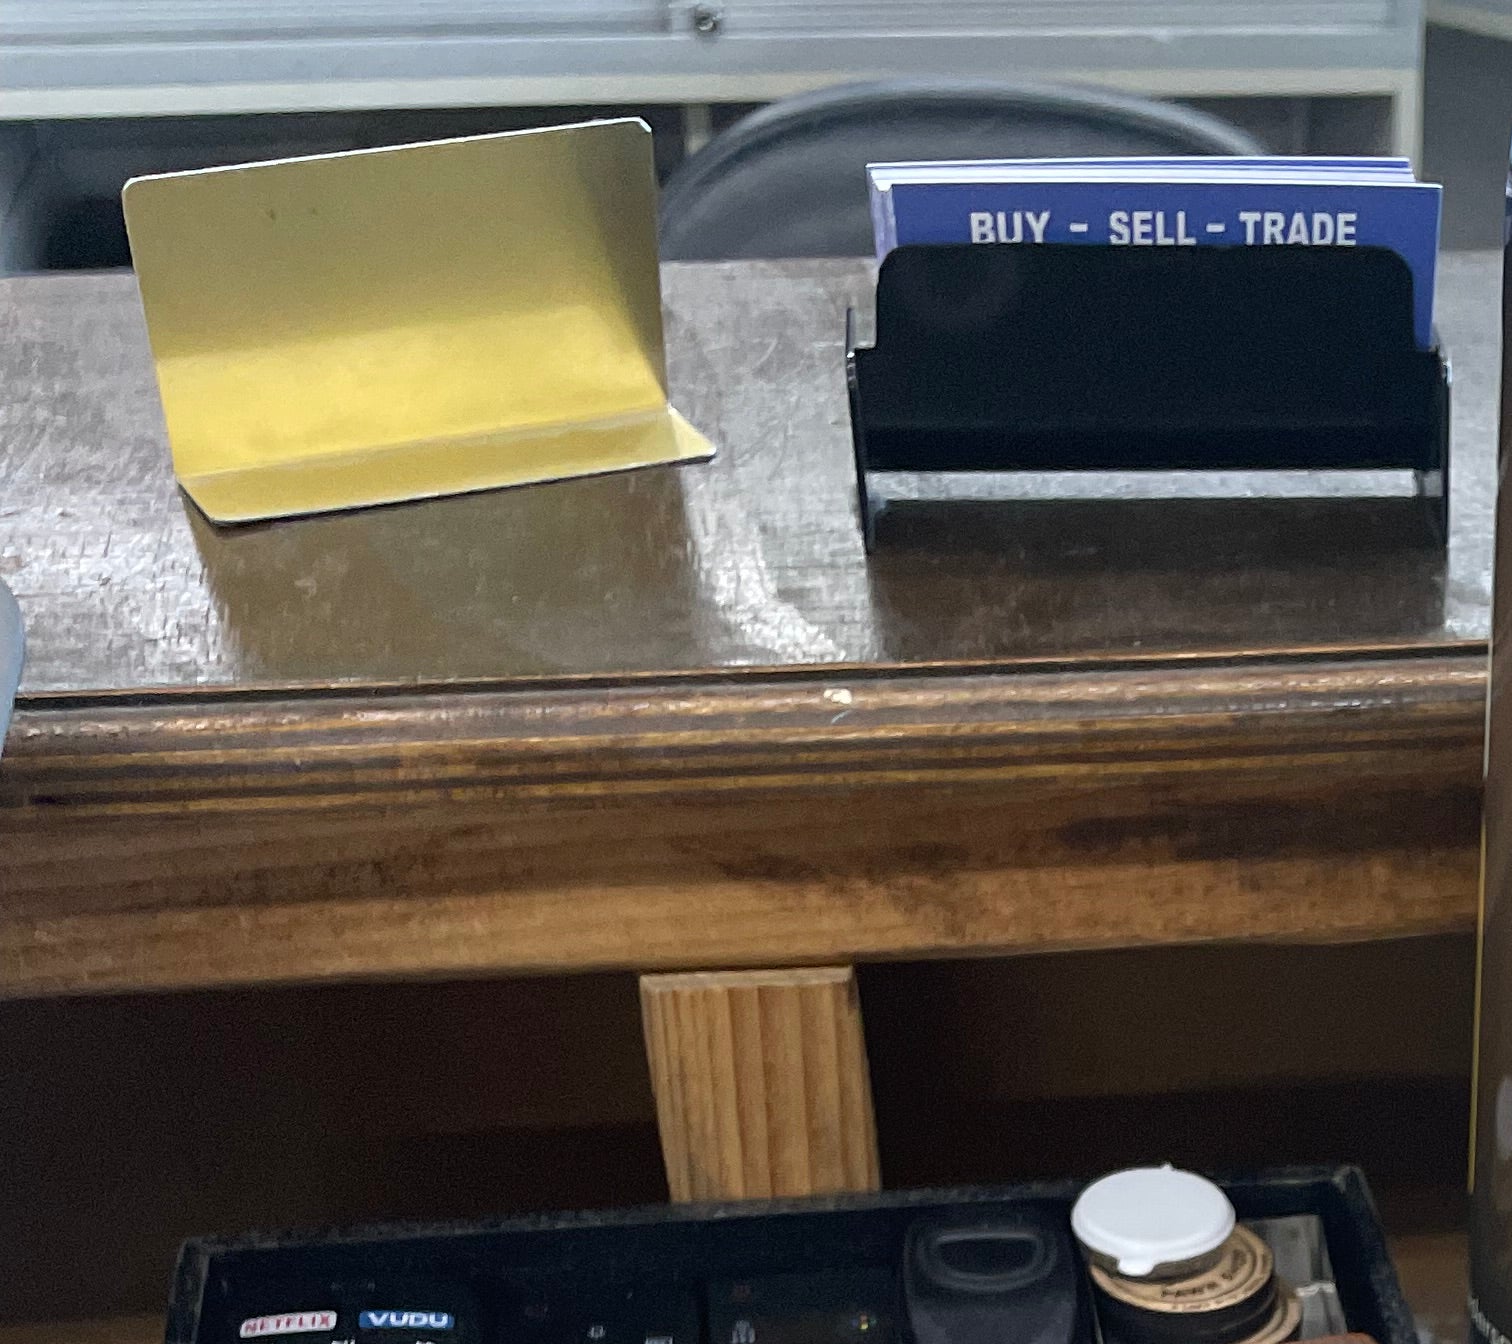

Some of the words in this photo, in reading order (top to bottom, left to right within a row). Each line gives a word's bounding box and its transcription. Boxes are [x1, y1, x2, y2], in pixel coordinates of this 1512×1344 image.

[969, 212, 1051, 244] BUY
[1109, 211, 1196, 246] SELL
[1240, 211, 1357, 246] TRADE
[244, 1314, 330, 1334] NETFLIX
[368, 1311, 449, 1329] VUDU
